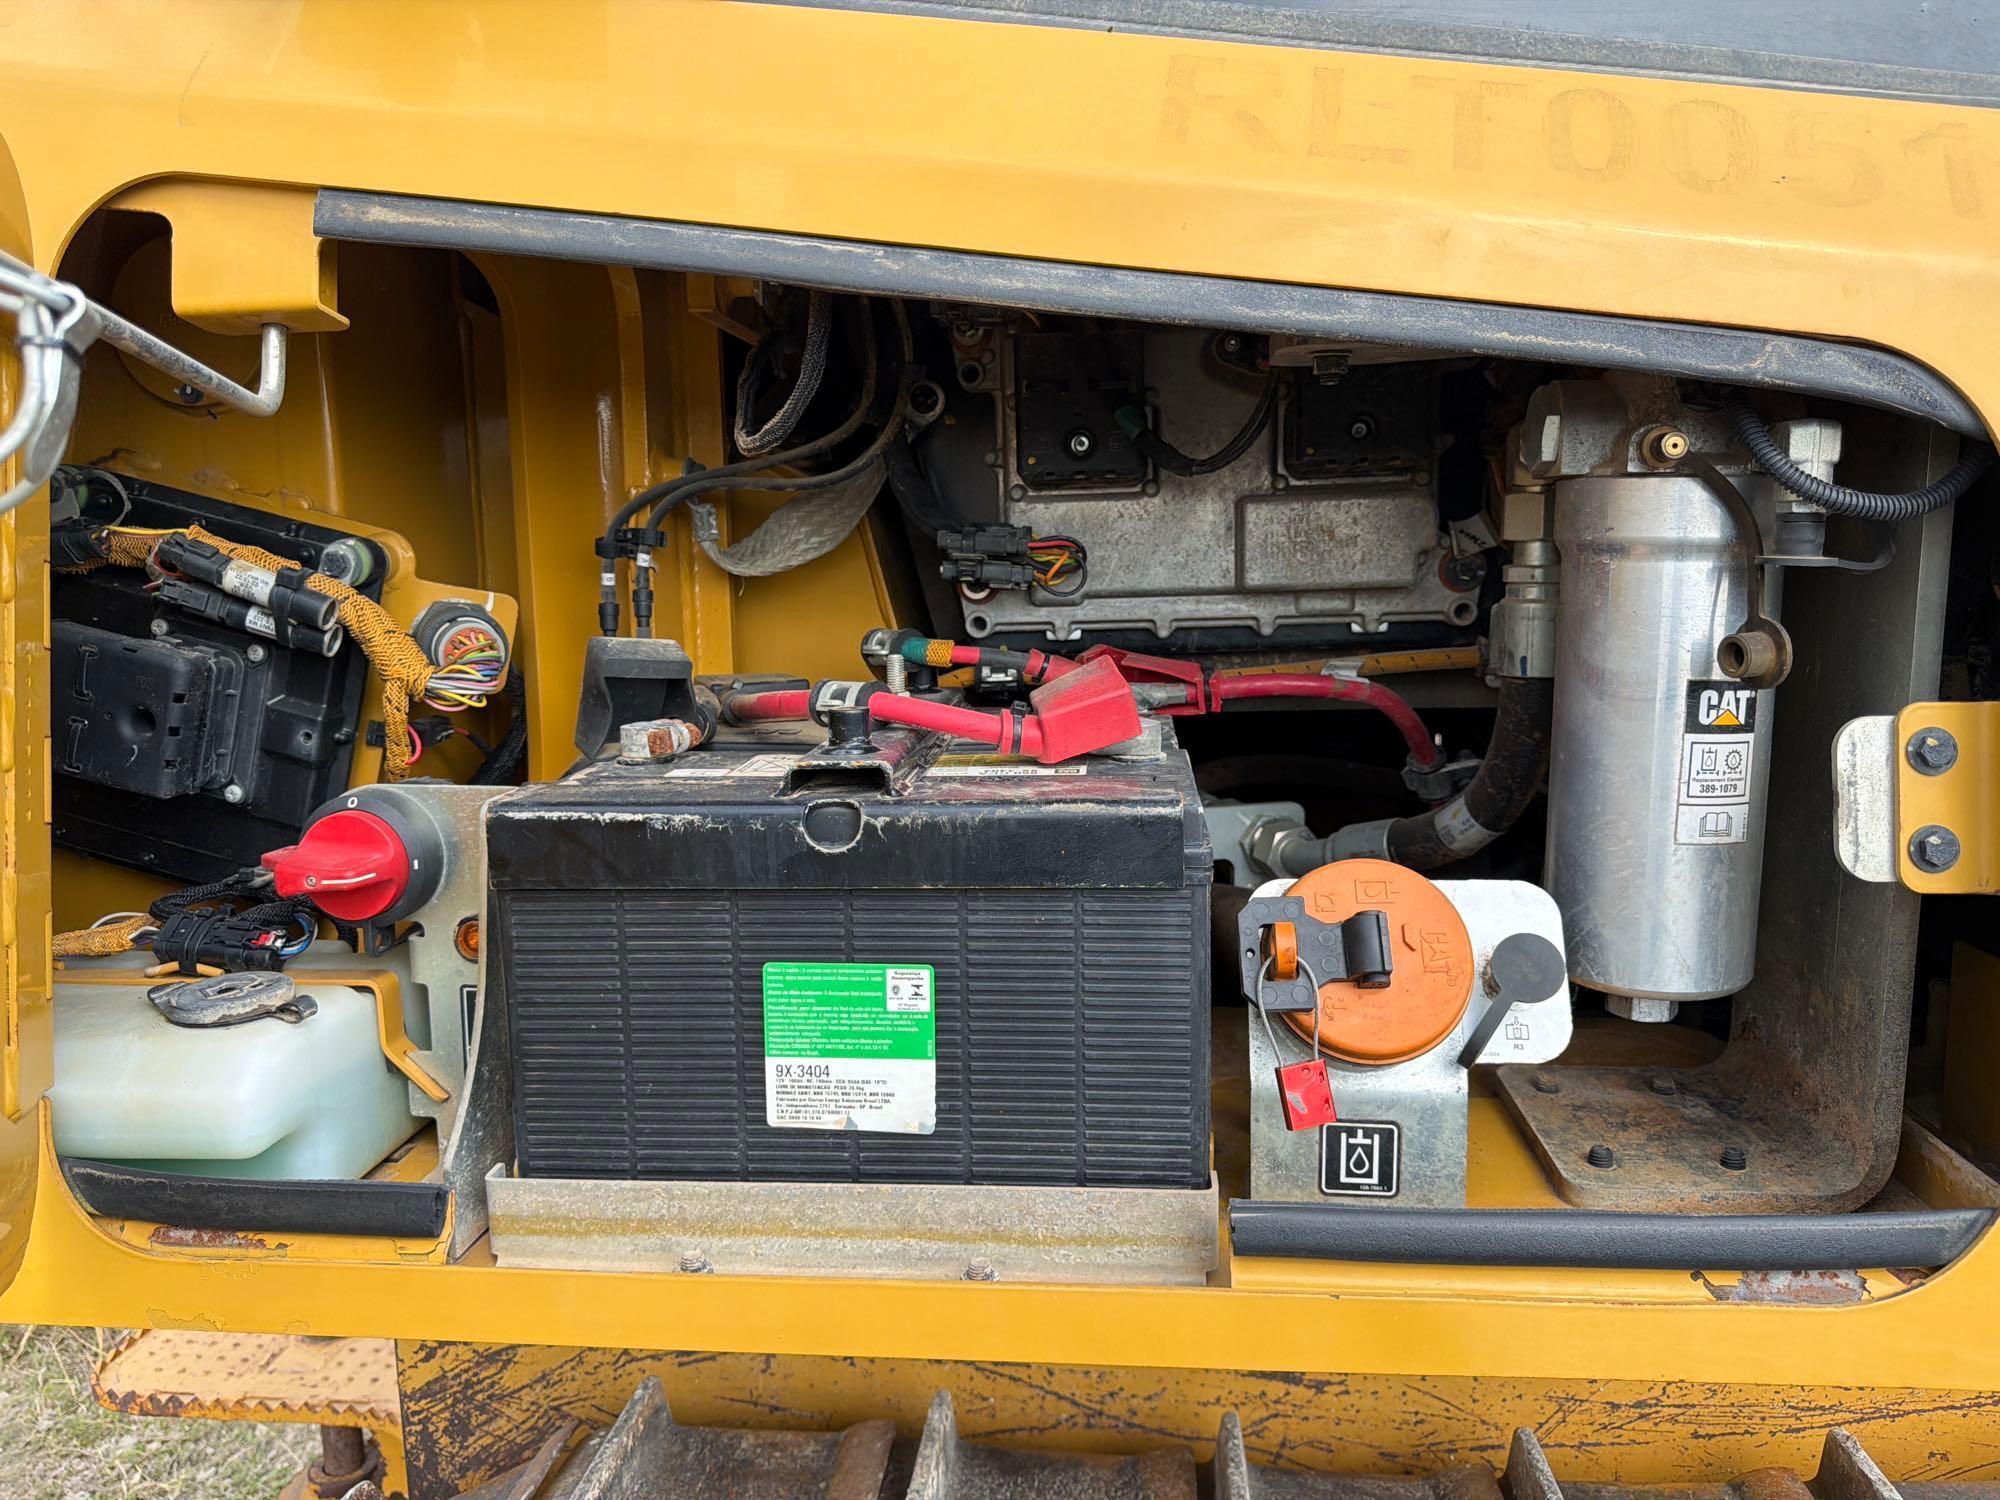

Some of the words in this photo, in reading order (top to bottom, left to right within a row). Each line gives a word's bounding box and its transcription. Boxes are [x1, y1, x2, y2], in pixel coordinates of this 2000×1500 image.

[1698, 688, 1752, 726] CAT
[1692, 776, 1726, 784] Replacement
[1726, 775, 1744, 783] Element
[775, 1064, 831, 1079] 9X-3404
